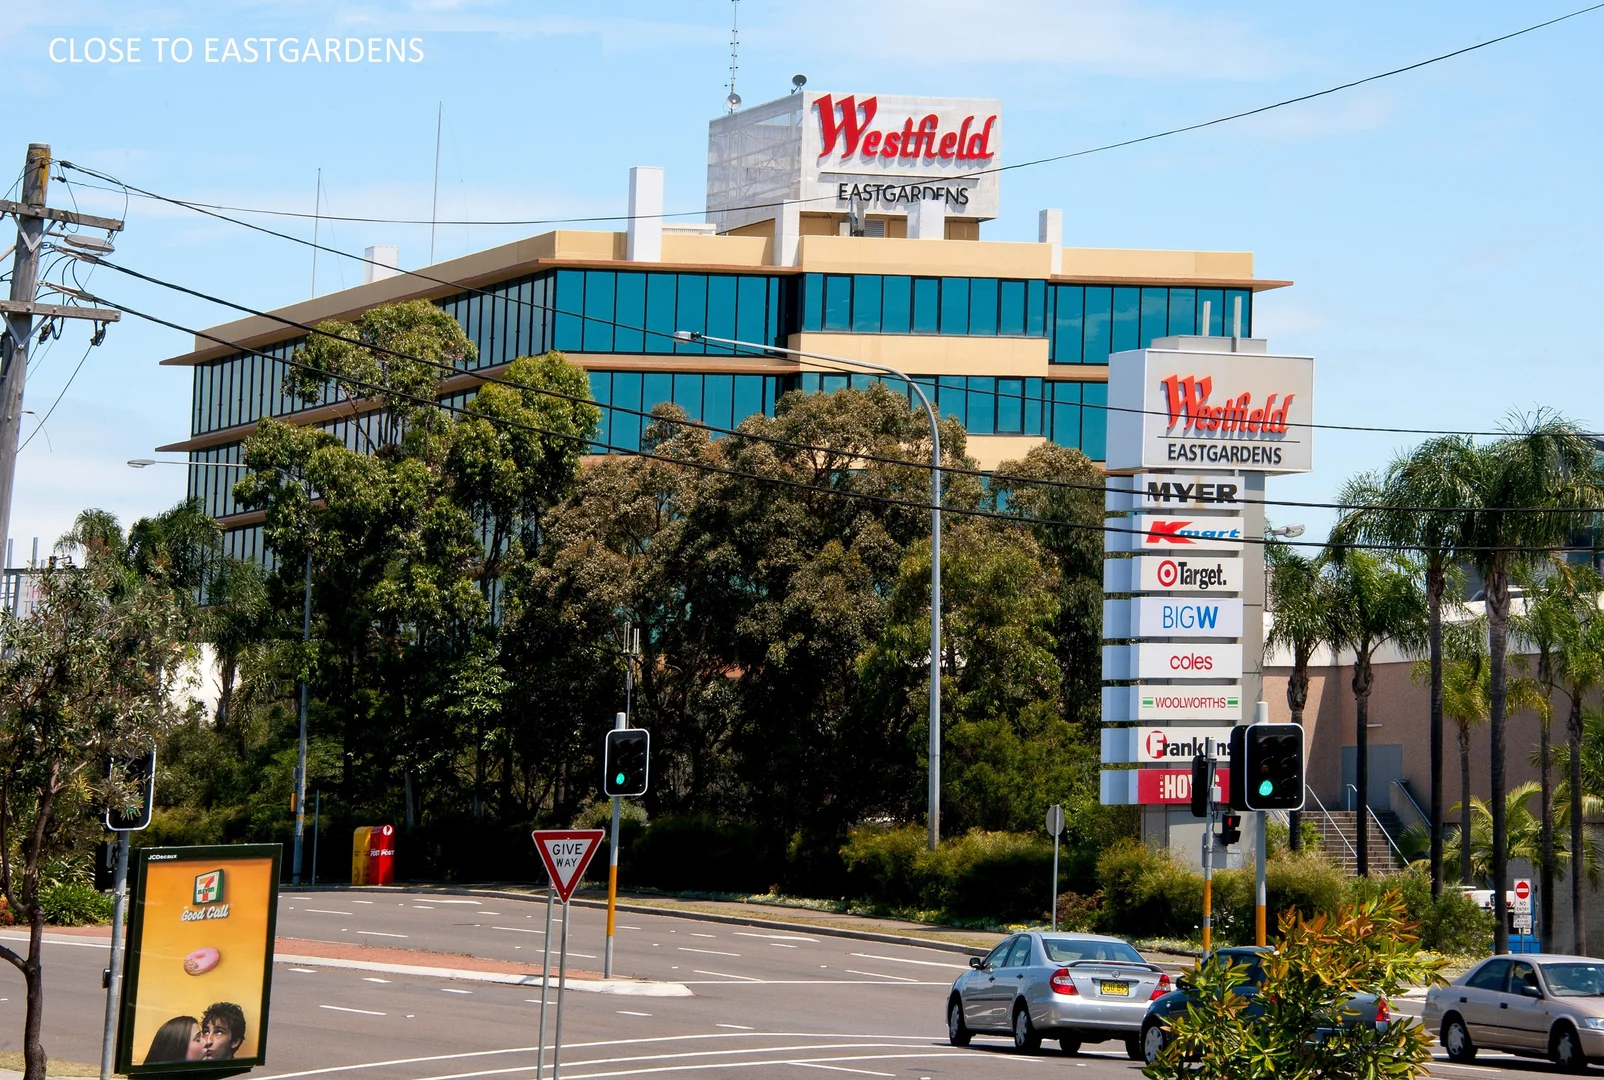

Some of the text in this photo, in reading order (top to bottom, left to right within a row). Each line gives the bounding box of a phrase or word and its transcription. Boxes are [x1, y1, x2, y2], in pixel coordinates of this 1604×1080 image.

[812, 93, 997, 160] Westfield
[838, 182, 969, 206] EASTGARDENS
[1161, 374, 1295, 434] Westfield
[1168, 443, 1282, 464] EASTGARDENS
[1147, 482, 1238, 504] MYER
[1146, 521, 1241, 545] Kmart
[1170, 653, 1213, 670] coles
[1155, 697, 1226, 709] WOOLWORTHS
[1148, 732, 1231, 757] Frankln
[552, 843, 583, 856] GIVE
[556, 858, 578, 868] WAY
[181, 904, 229, 921] Good Call
